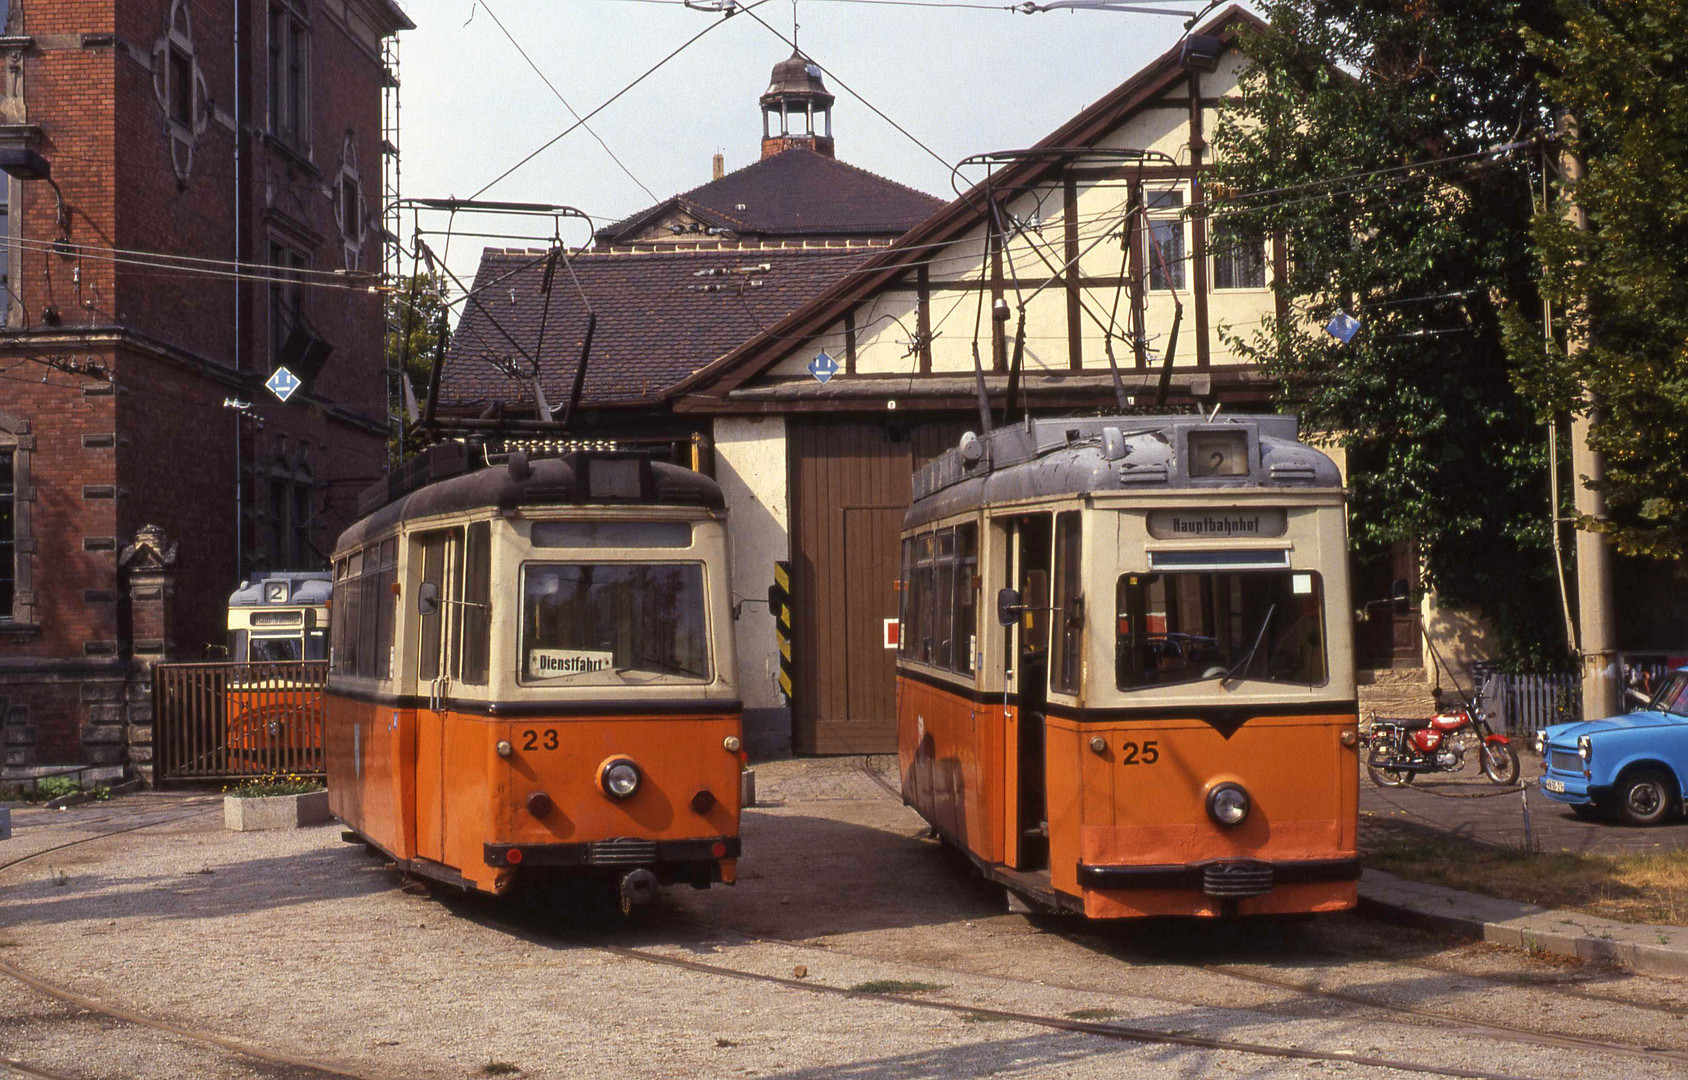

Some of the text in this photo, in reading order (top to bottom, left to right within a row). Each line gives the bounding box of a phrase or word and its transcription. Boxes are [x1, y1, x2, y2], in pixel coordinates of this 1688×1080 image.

[1210, 451, 1224, 471] 2
[1173, 517, 1259, 535] Hauptbahnhof
[270, 585, 282, 600] 2
[540, 654, 603, 673] Dienstfahrt
[522, 729, 560, 751] 23
[1122, 740, 1159, 765] 25
